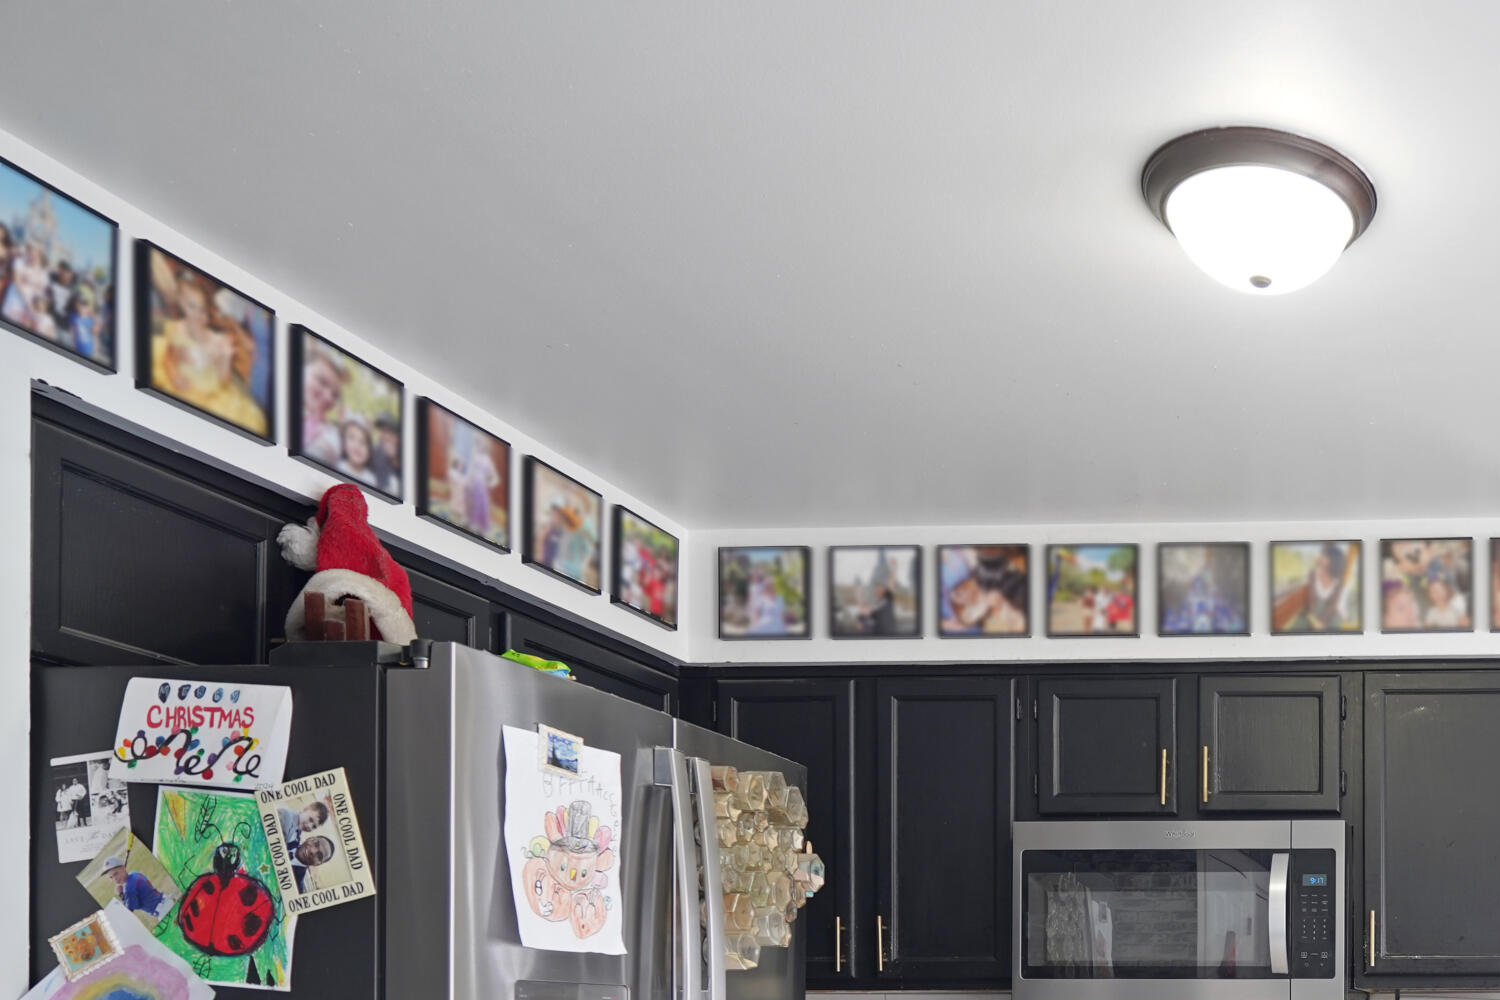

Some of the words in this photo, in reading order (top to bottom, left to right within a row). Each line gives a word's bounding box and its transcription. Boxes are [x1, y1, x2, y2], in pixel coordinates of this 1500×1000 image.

[147, 705, 255, 729] CHRISTMAS
[260, 790, 283, 804] ONE
[283, 780, 312, 798] COOL
[313, 773, 336, 789] DAD
[333, 793, 348, 816] ONE
[263, 813, 278, 837] DAD
[338, 816, 355, 846] COOL
[270, 837, 285, 867] COOL
[347, 847, 363, 870] DAD
[277, 868, 292, 891] ONE
[288, 897, 311, 913] ONE
[312, 888, 340, 906] COOL
[341, 881, 364, 898] DAD
